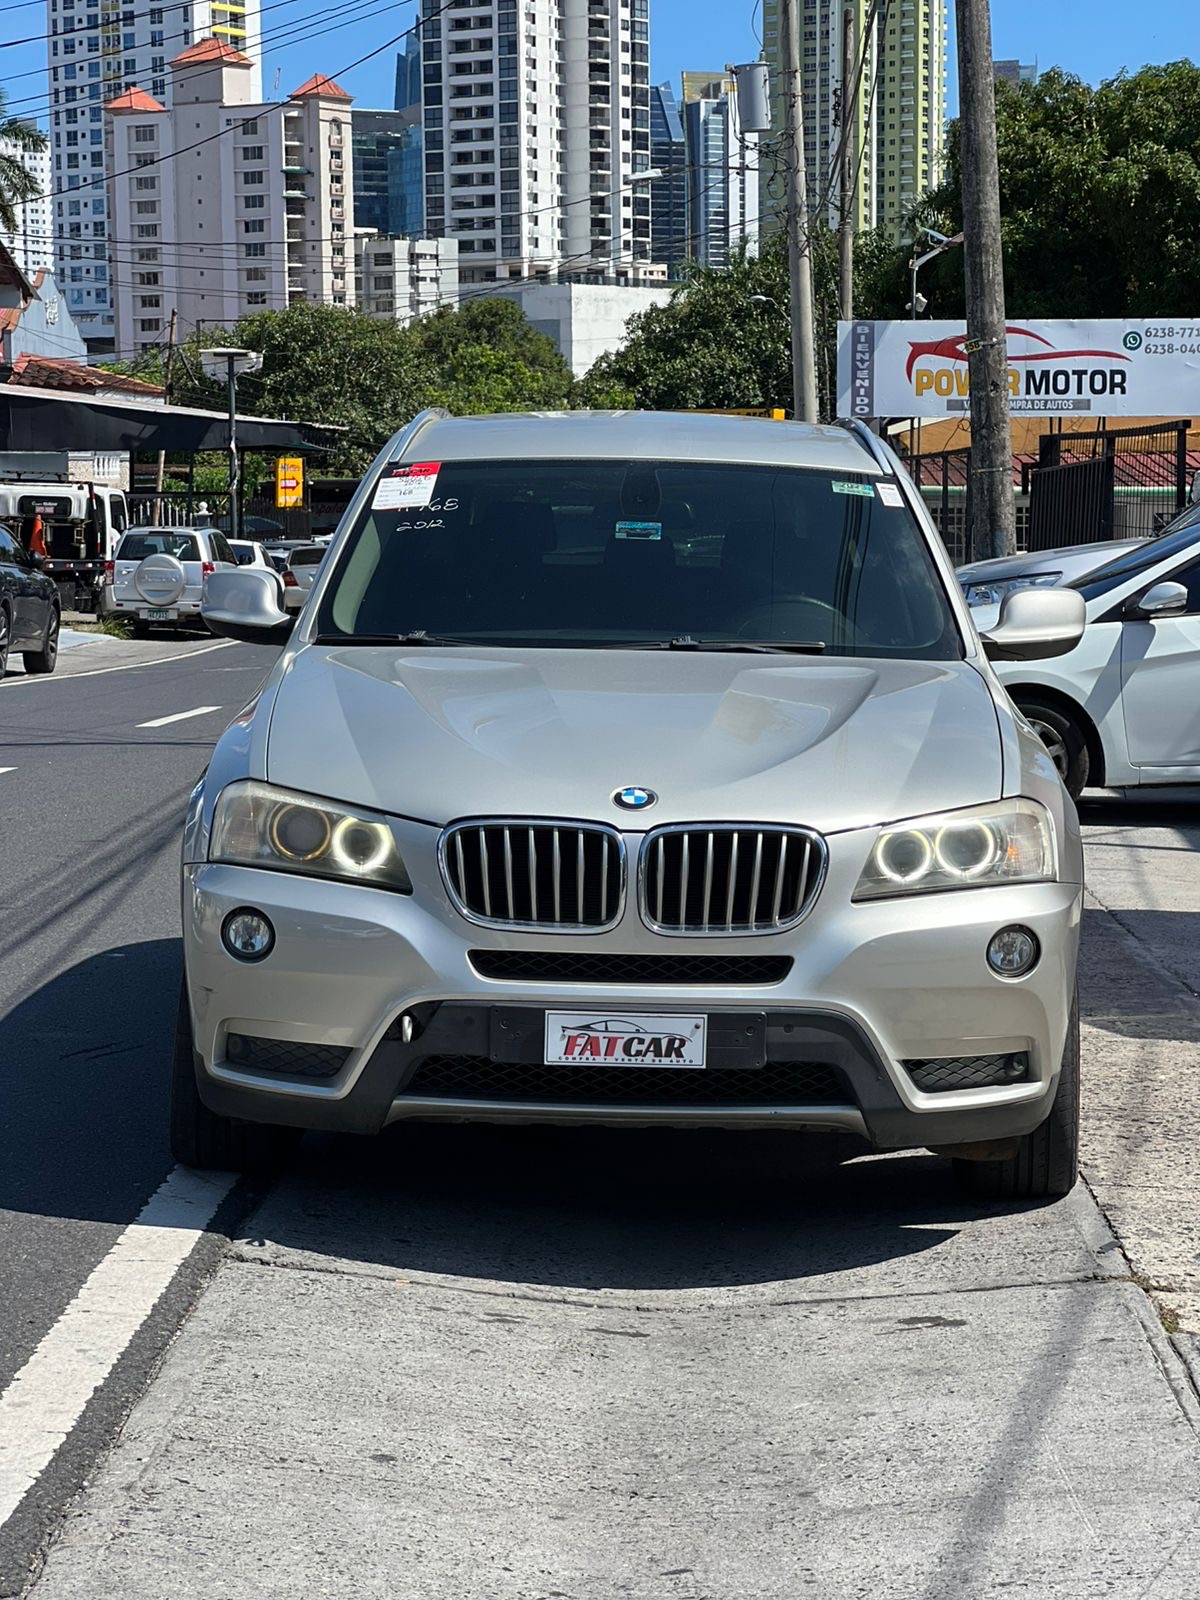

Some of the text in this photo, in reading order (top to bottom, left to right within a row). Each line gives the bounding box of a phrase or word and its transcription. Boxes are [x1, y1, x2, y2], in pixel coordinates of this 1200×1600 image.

[855, 326, 870, 414] BIENVENIDO
[915, 368, 1127, 396] POWR MOTOR
[1008, 400, 1073, 409] MPRA DE AUTOS
[396, 519, 446, 532] 2012
[563, 1034, 688, 1058] FATCAR
